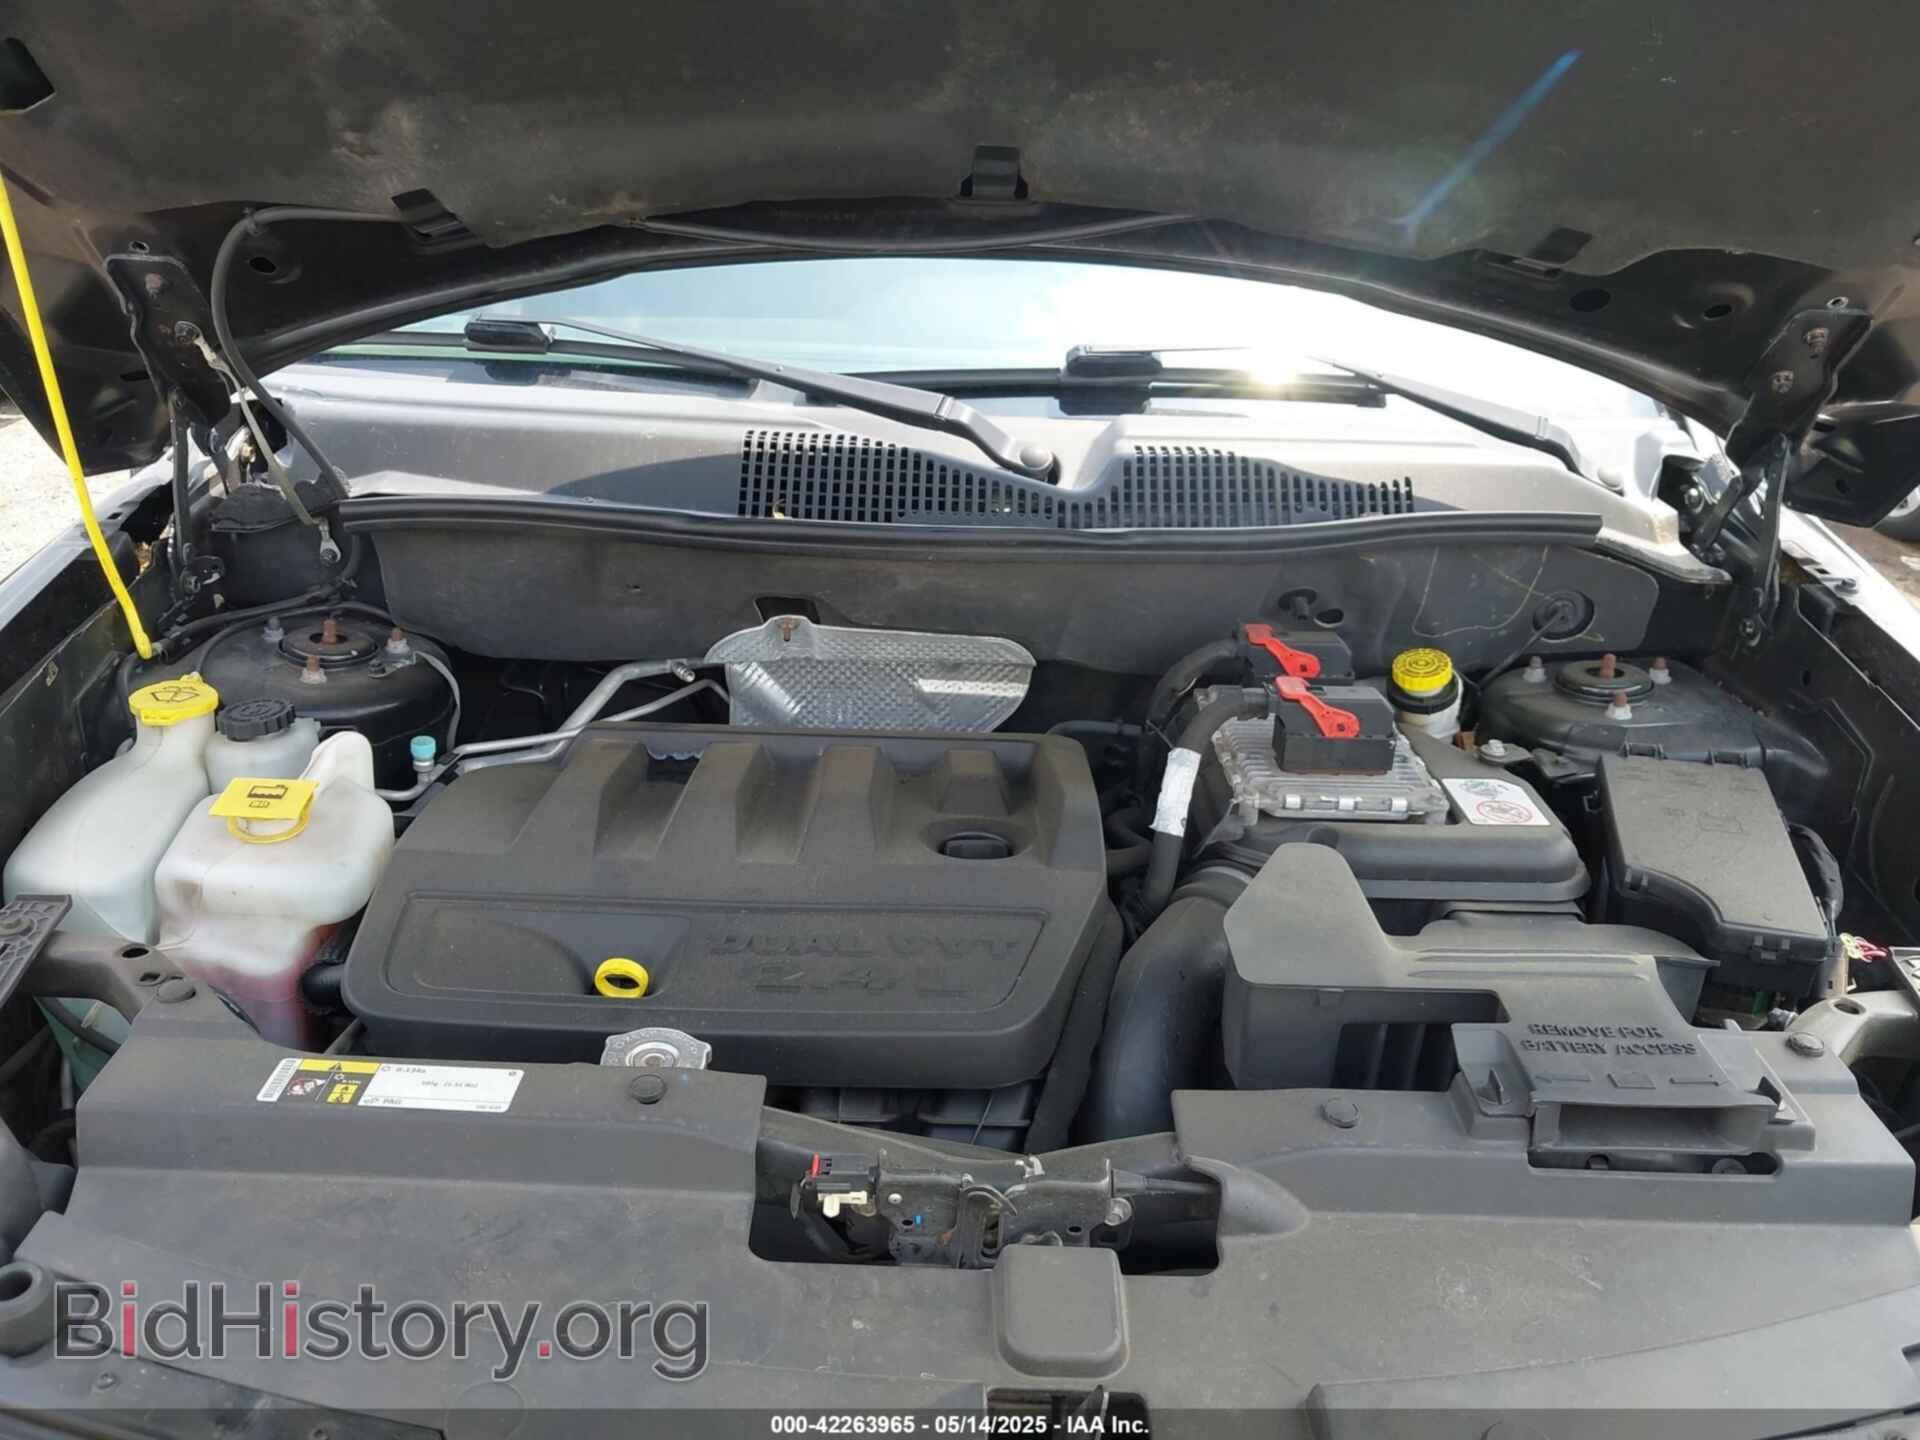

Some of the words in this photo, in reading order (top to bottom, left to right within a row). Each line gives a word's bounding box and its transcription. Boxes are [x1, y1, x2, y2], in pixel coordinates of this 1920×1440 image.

[1527, 1023, 1616, 1038] REMOVE
[1617, 1026, 1665, 1039] FOR
[1520, 1040, 1608, 1055] BATTERY
[1615, 1043, 1697, 1056] ACCESS
